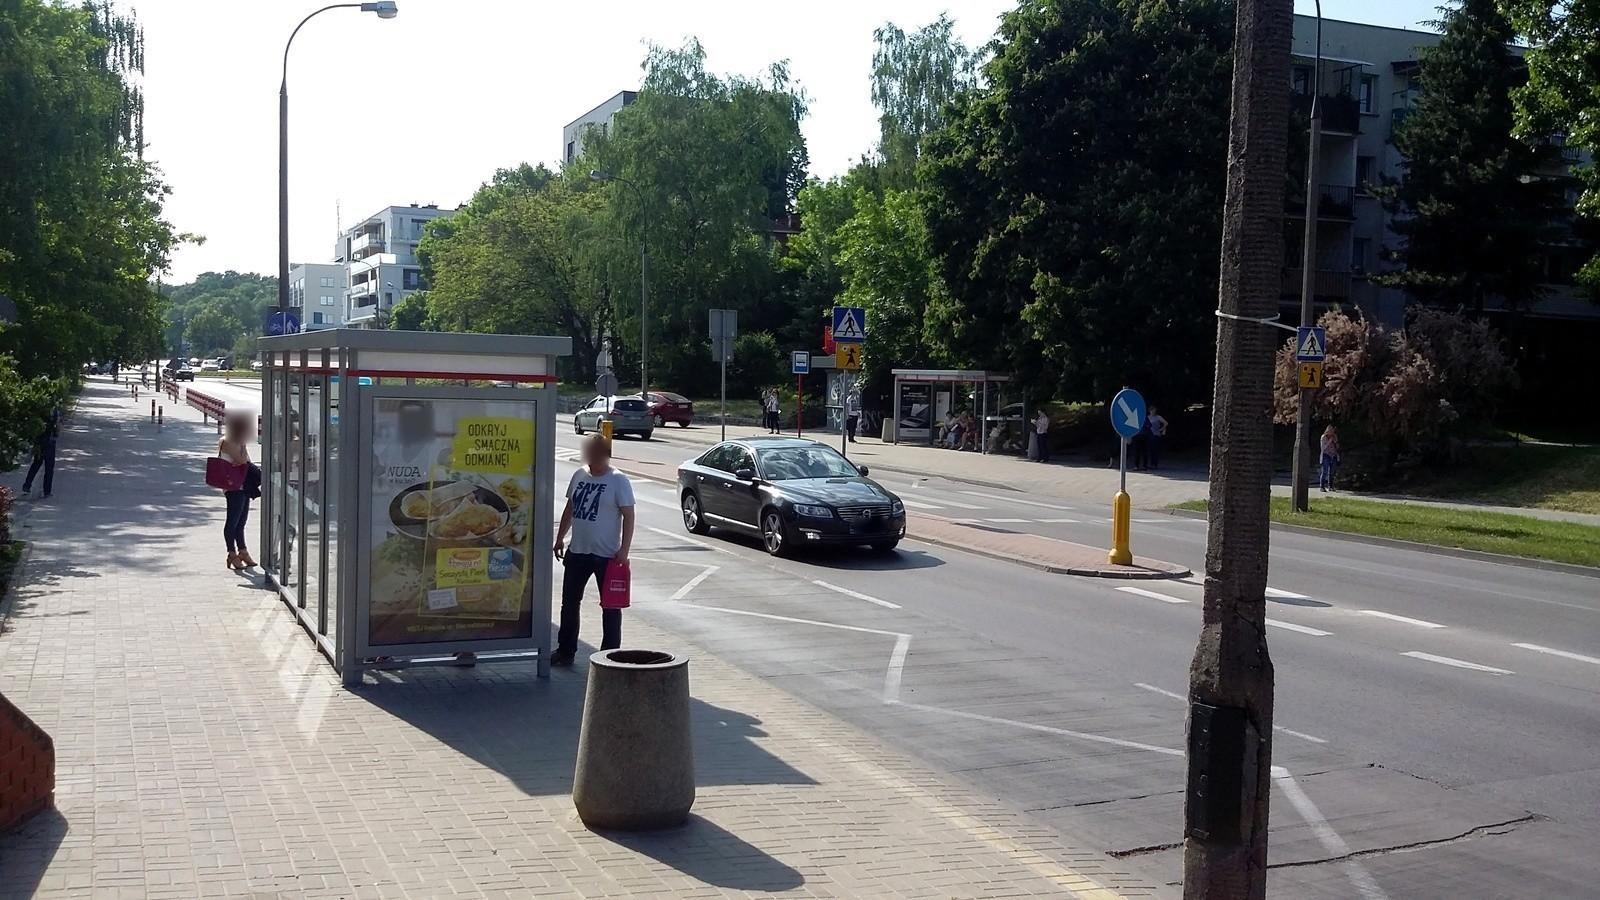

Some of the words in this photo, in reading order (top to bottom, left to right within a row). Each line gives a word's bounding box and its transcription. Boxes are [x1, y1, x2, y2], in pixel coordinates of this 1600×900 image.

[468, 424, 507, 437] ODKRYJ
[465, 453, 510, 468] ODMIANĘ!
[388, 466, 421, 477] NUDA
[577, 481, 607, 494] SAVE
[572, 489, 591, 511] ME
[588, 492, 601, 513] A
